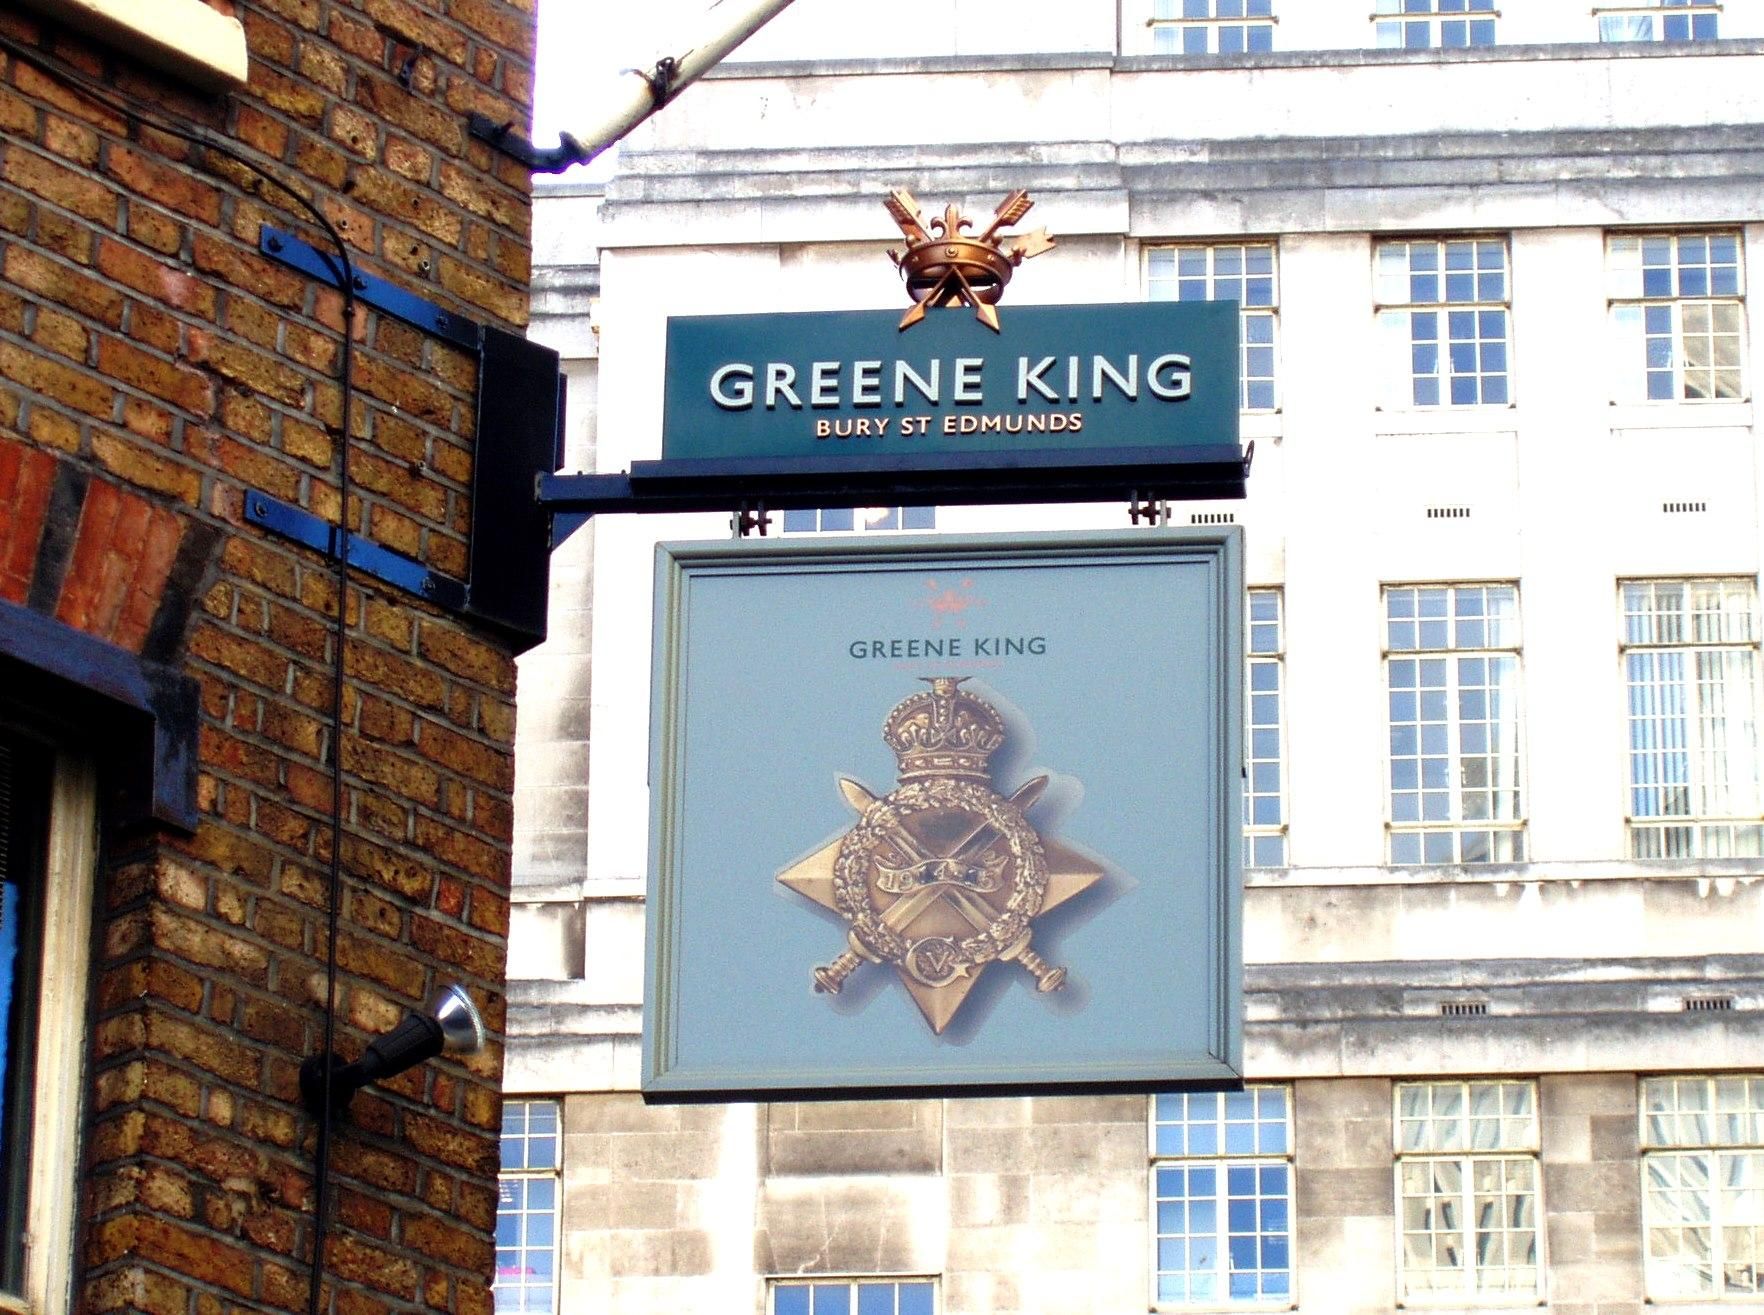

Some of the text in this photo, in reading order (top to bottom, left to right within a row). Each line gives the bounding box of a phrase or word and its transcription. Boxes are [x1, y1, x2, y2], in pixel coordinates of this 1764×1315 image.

[709, 353, 1193, 408] GREENE KING
[816, 412, 1083, 437] BURY ST EDMUNDS
[849, 636, 1047, 660] GREENE KING
